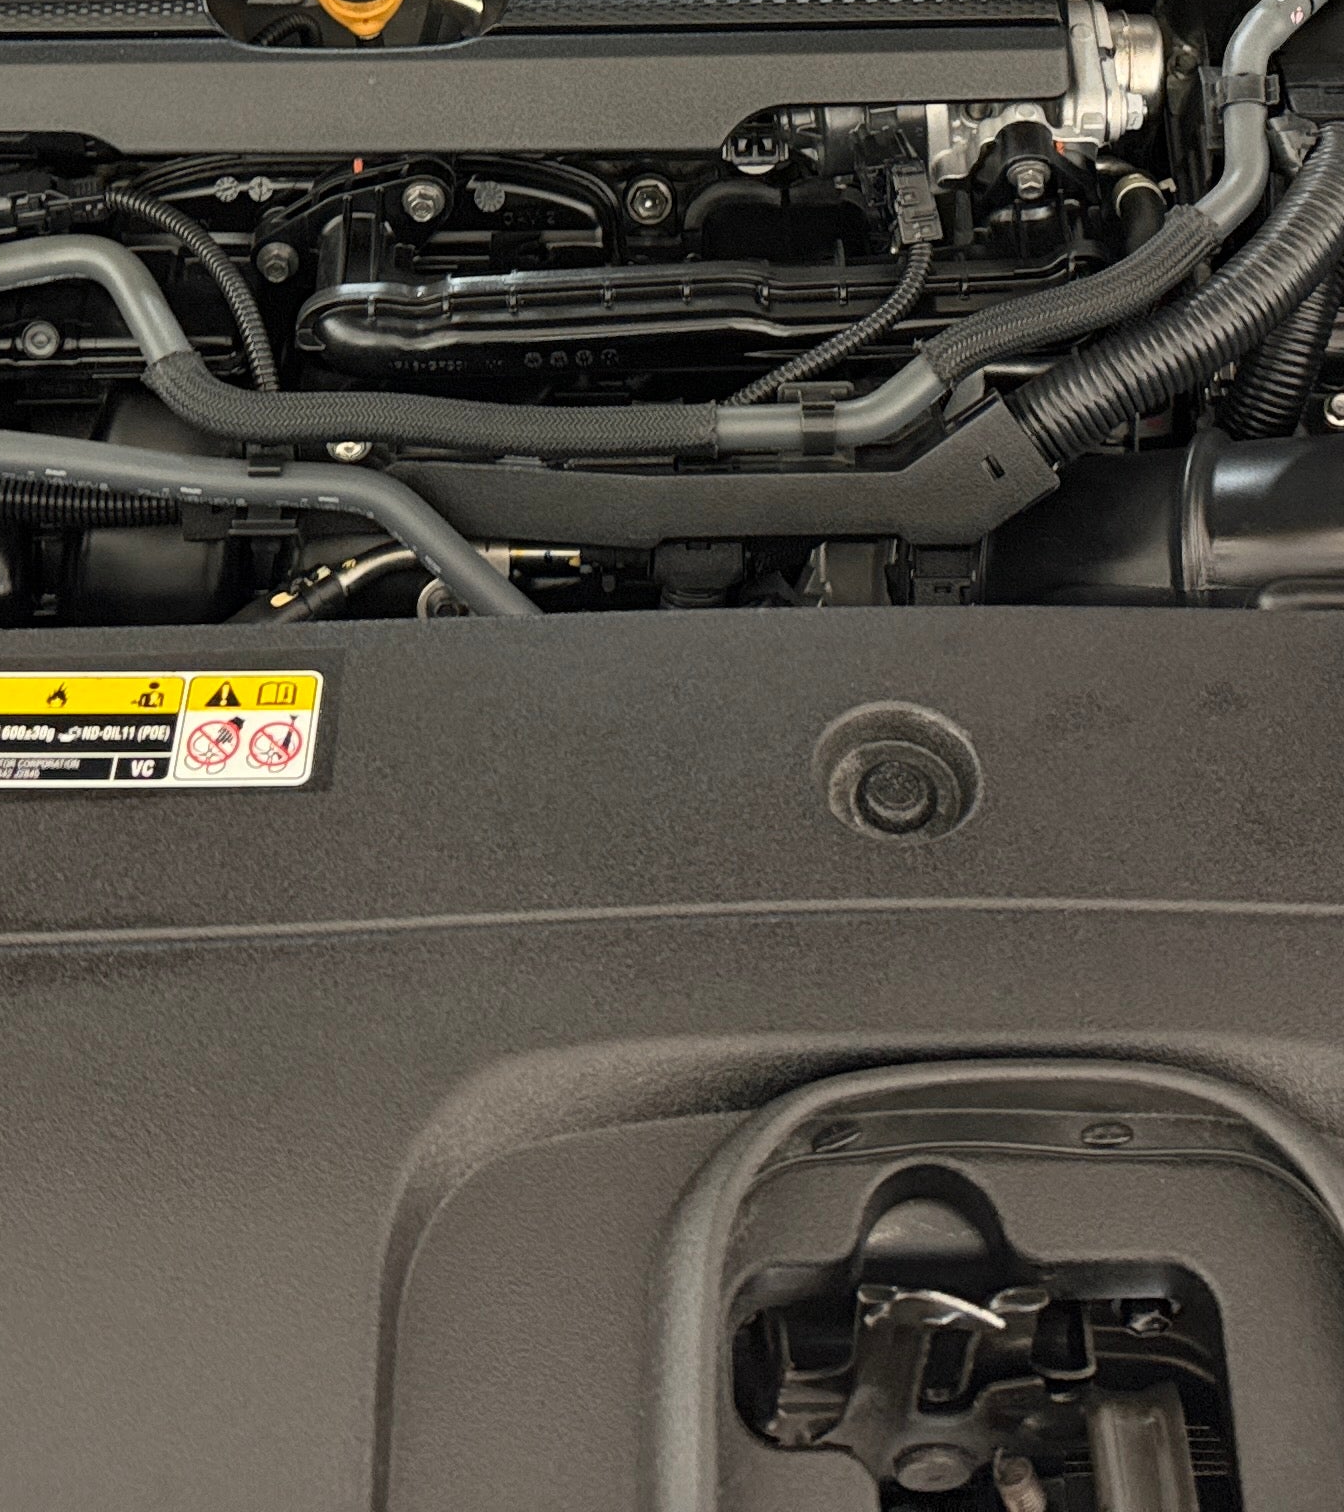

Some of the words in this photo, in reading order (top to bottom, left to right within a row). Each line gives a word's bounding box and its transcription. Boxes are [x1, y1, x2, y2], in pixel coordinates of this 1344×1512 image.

[81, 724, 137, 742] ND-OIL11
[137, 724, 171, 743] (POE)
[17, 759, 81, 770] CORPORATION
[131, 759, 156, 778] VC
